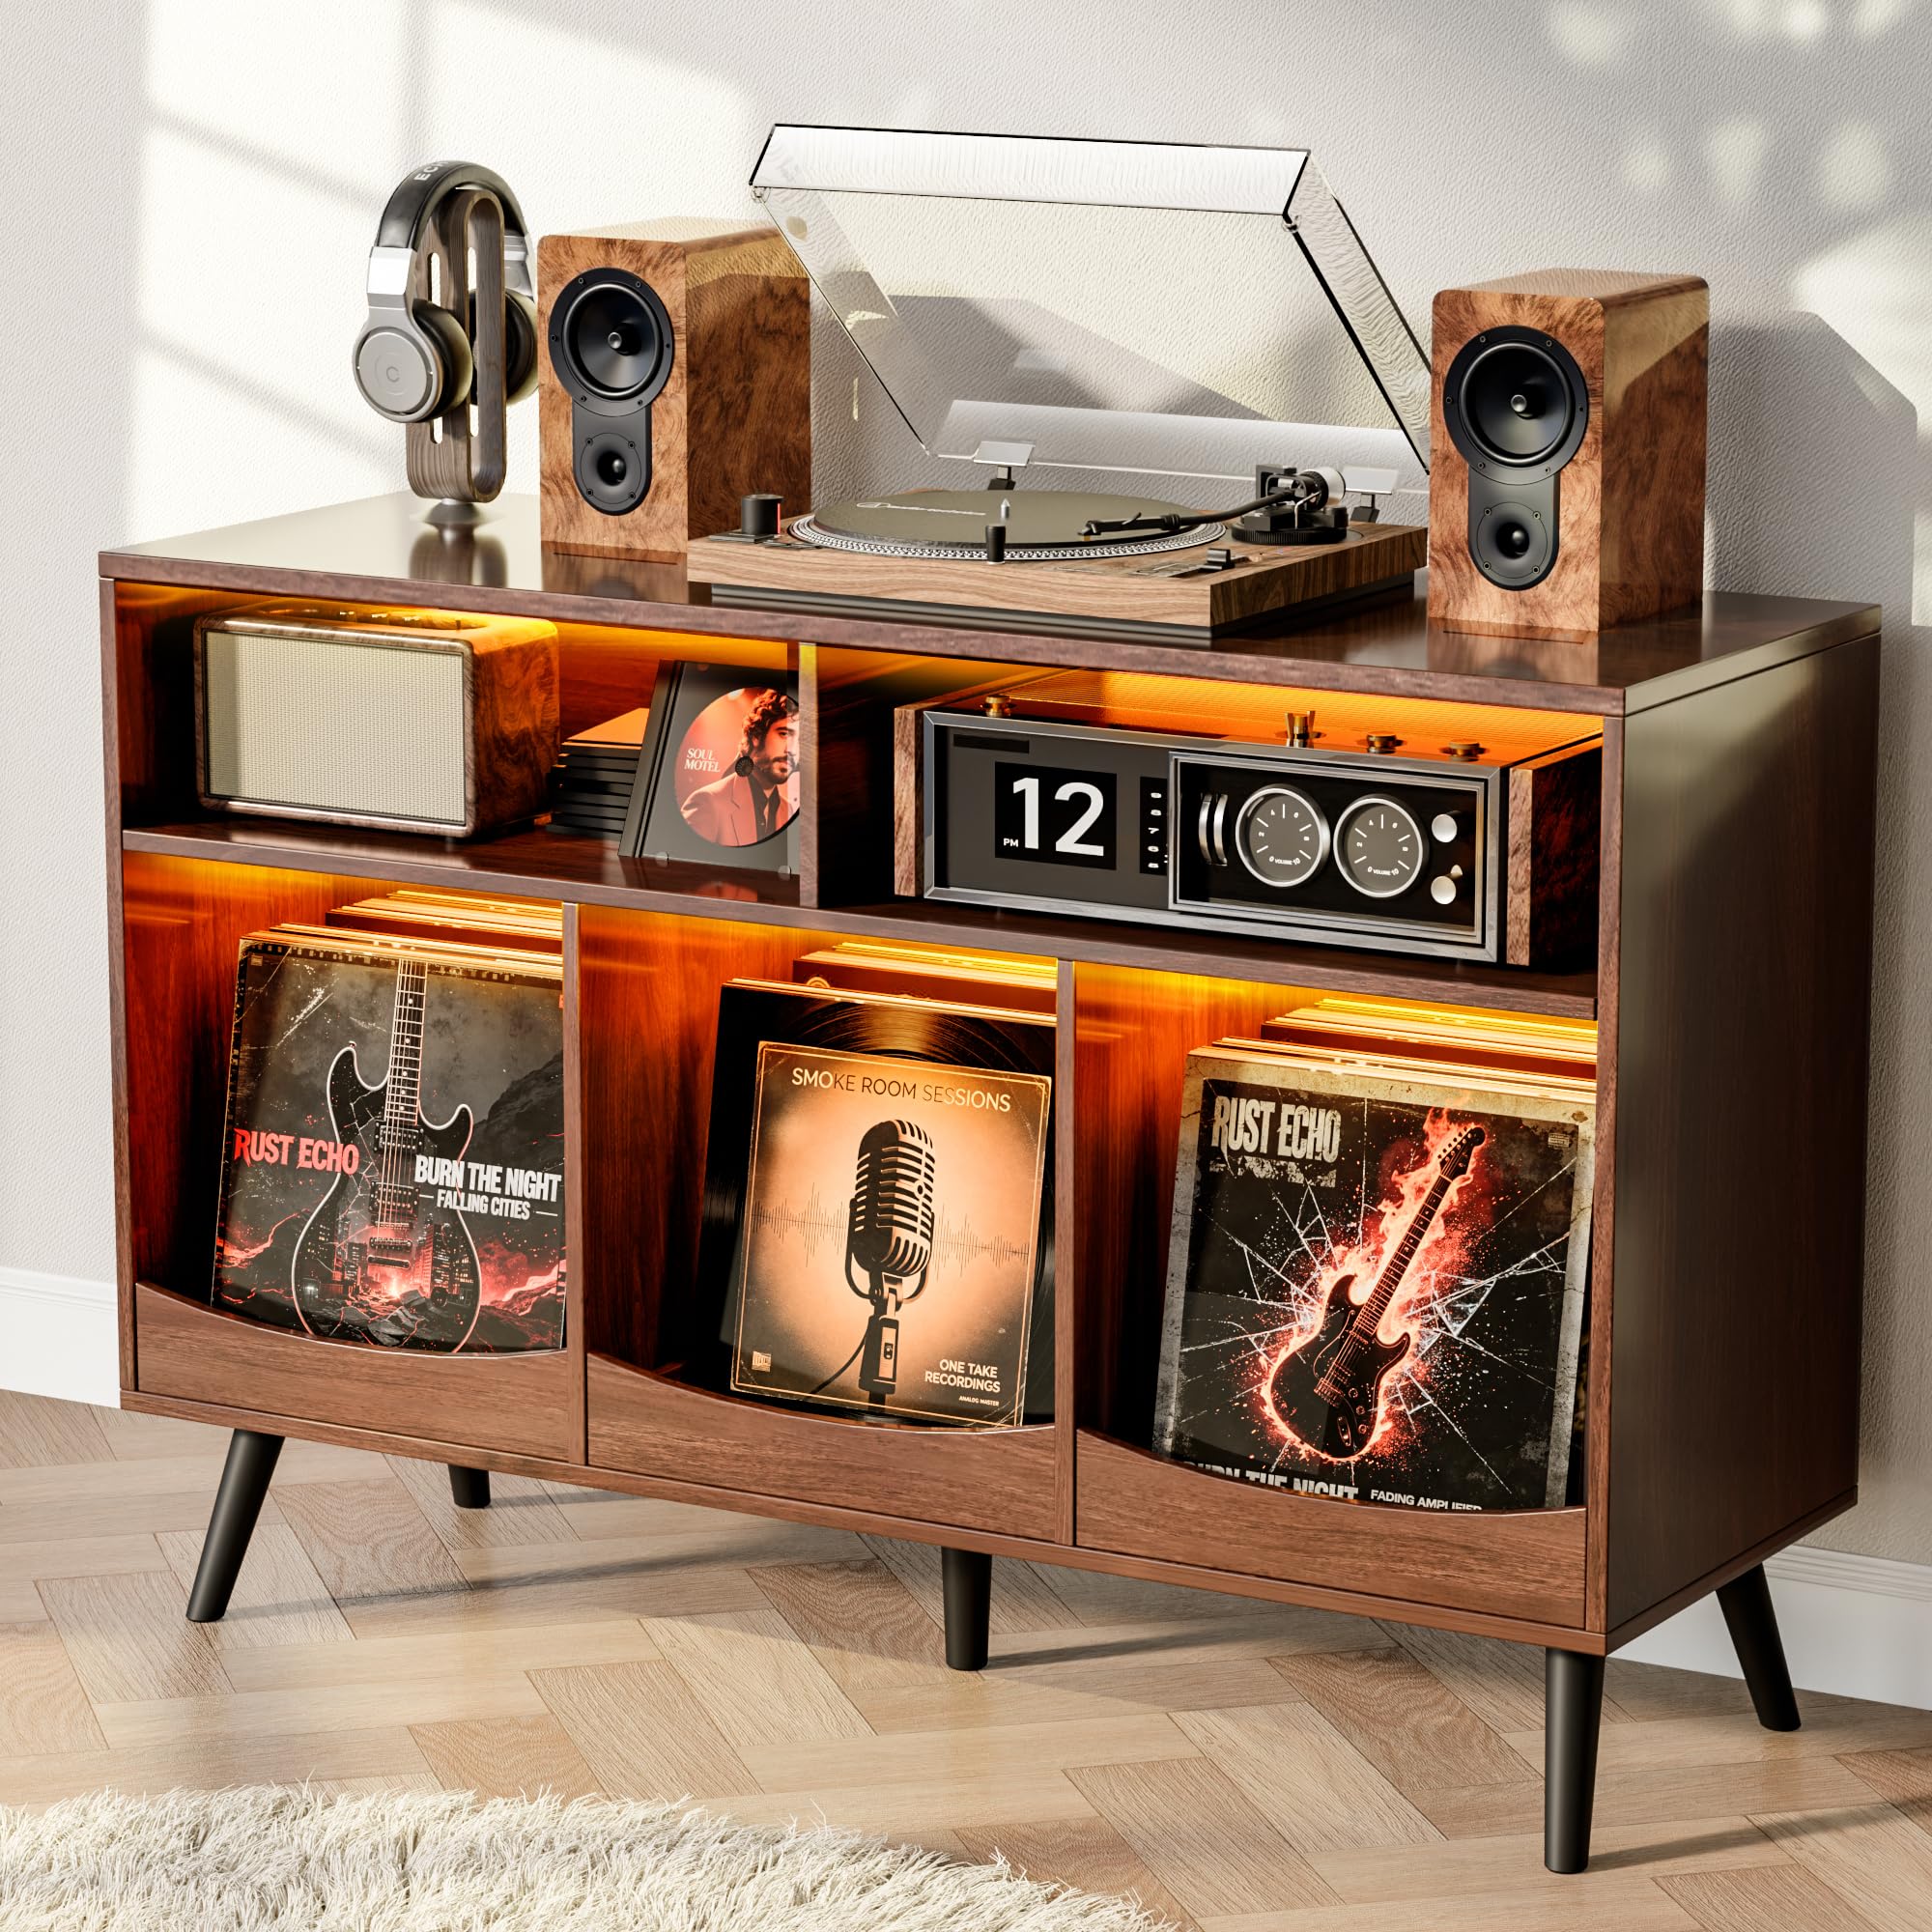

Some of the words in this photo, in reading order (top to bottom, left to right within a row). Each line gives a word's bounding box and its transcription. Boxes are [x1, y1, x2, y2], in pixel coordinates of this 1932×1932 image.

[684, 758, 721, 773] MOTEL
[687, 748, 714, 761] SOUL
[1012, 777, 1104, 857] 12
[1003, 838, 1019, 848] PM
[791, 1067, 857, 1092] SMOKE
[862, 1076, 917, 1099] ROOM
[923, 1084, 1011, 1112] SESSIONS
[1210, 1095, 1276, 1155] RUST
[1276, 1102, 1342, 1163] ECHO
[233, 1127, 295, 1167] RUST
[296, 1137, 360, 1176] ECHO
[413, 1154, 466, 1189] BURN
[468, 1161, 503, 1194] THE
[504, 1167, 562, 1203] NIGHT
[437, 1188, 489, 1214] FALLING
[491, 1196, 531, 1220] CITIES
[939, 1358, 966, 1374] ONE
[967, 1363, 999, 1378] TAKE
[924, 1370, 1001, 1393] RECORDINGS
[958, 1395, 980, 1404] ANALOG
[980, 1398, 1000, 1406] MASTER
[1370, 1489, 1415, 1506] FADING
